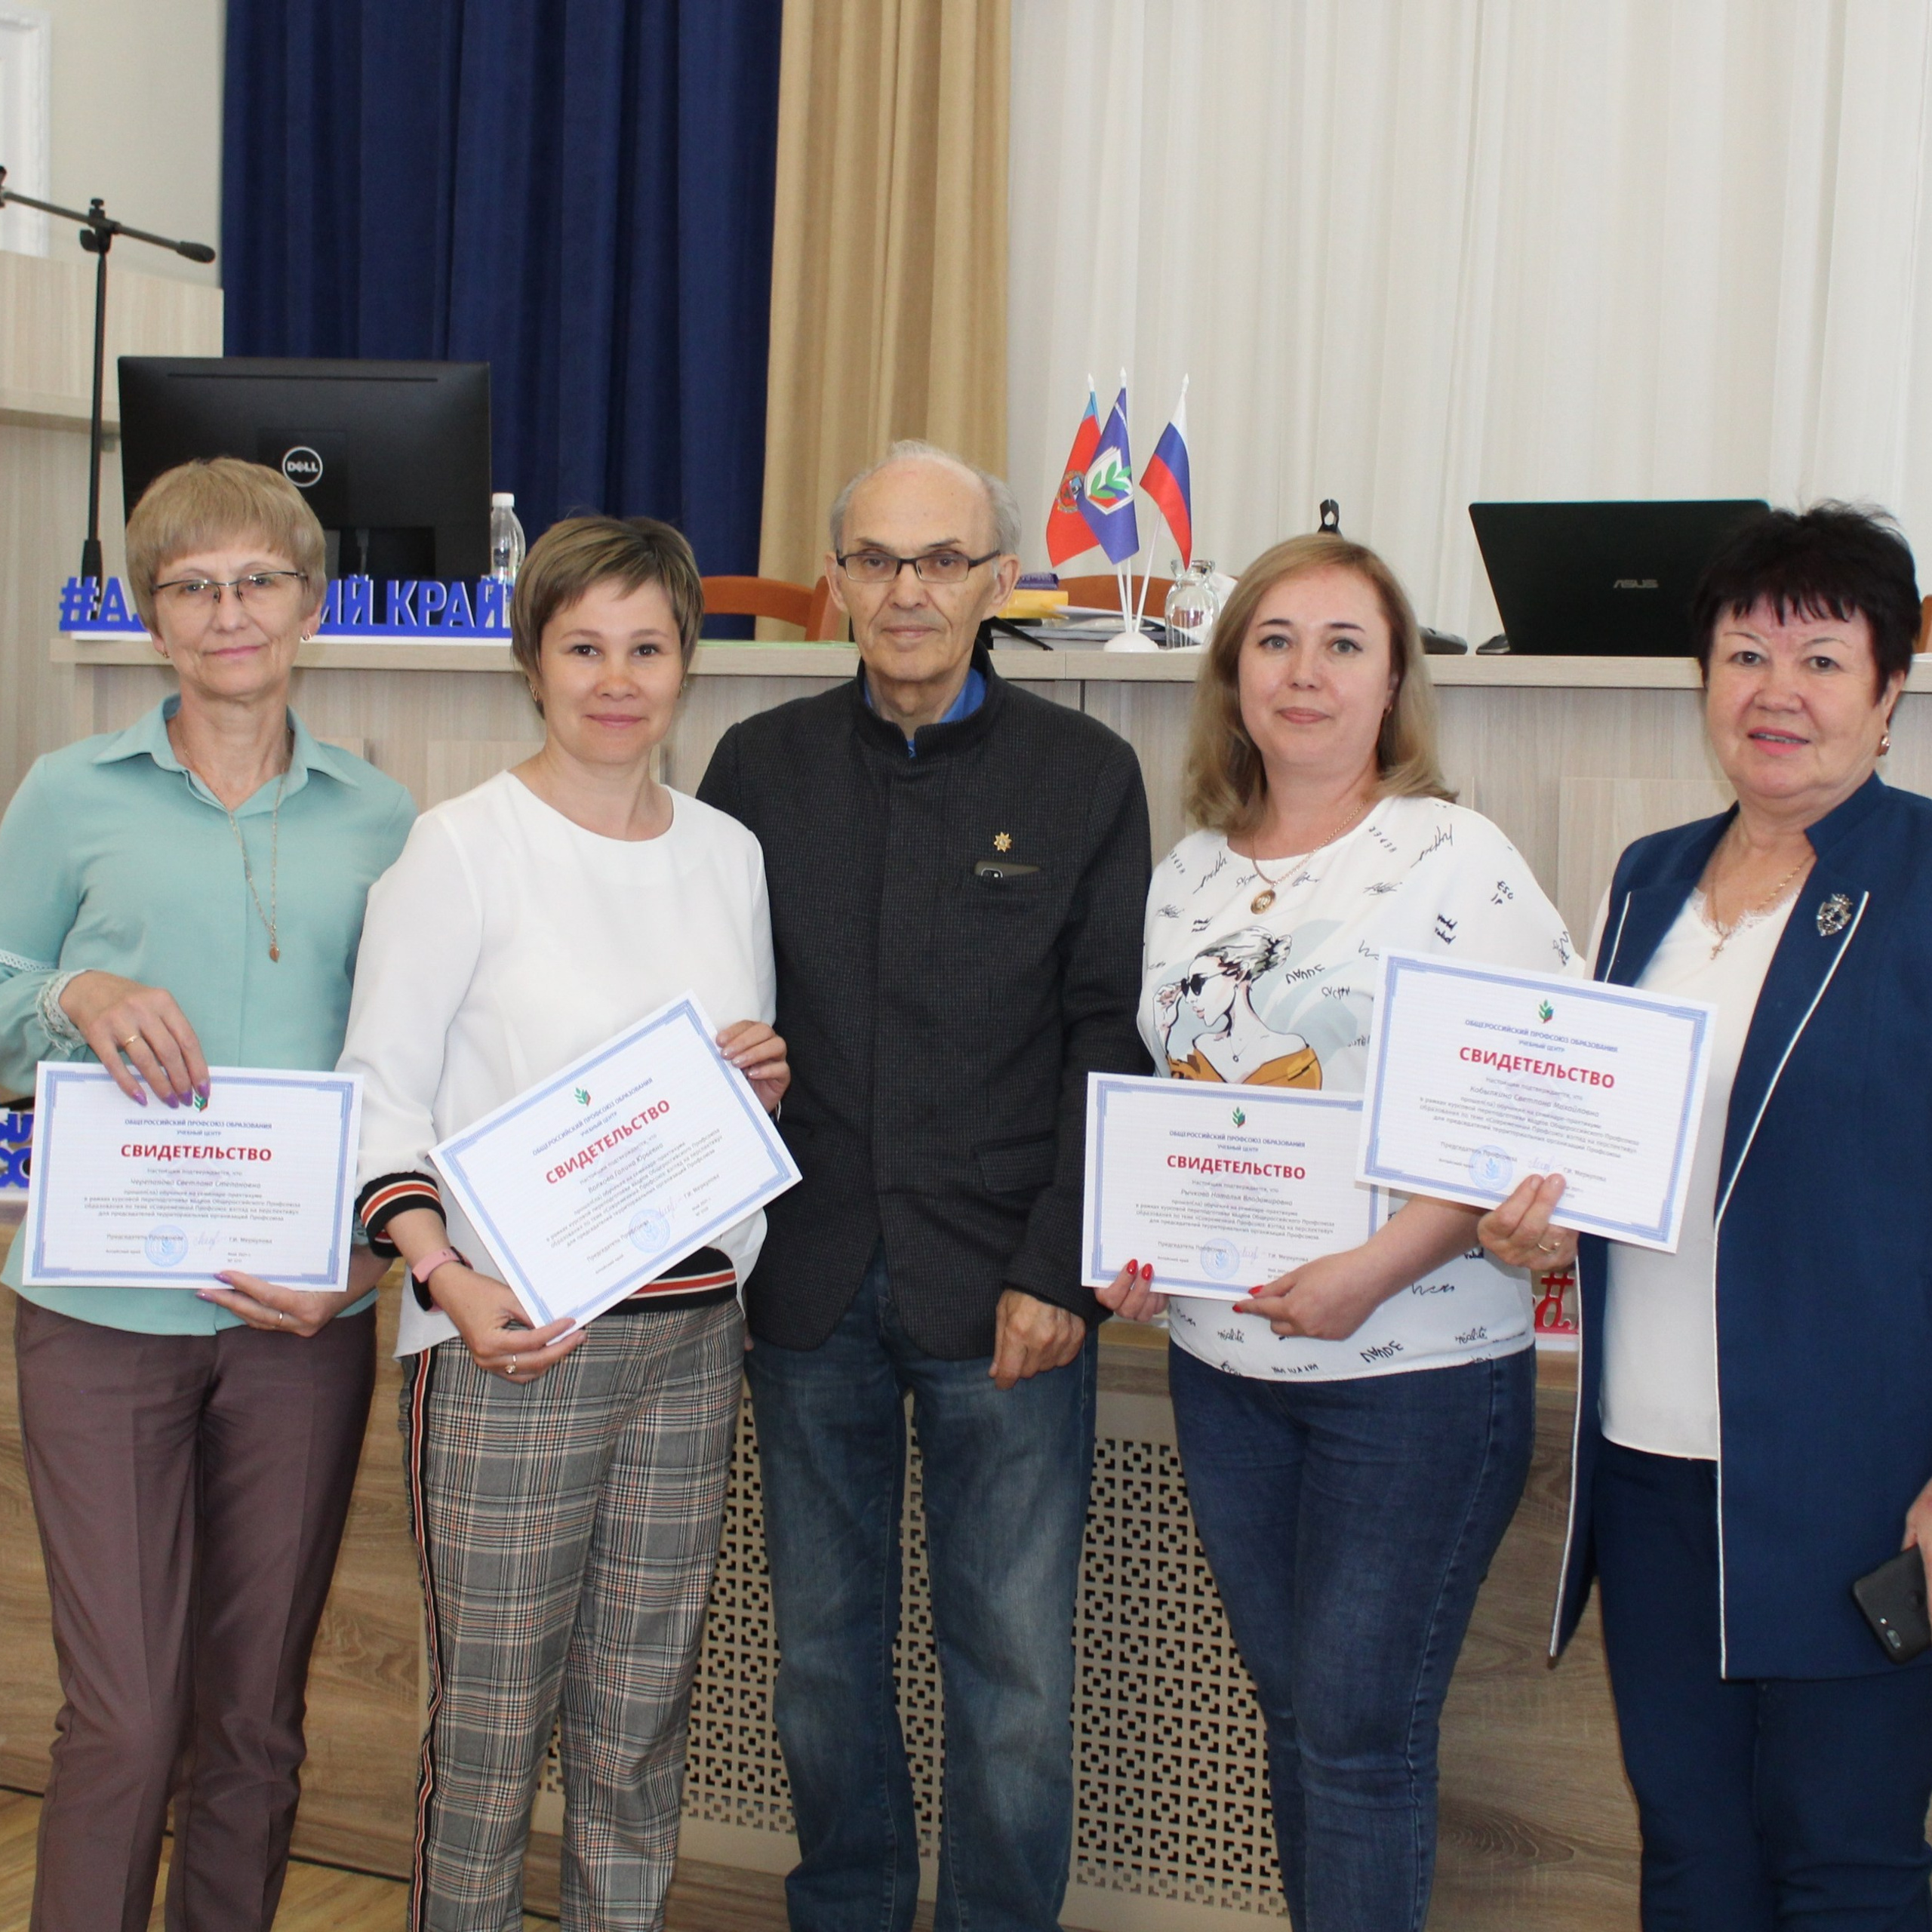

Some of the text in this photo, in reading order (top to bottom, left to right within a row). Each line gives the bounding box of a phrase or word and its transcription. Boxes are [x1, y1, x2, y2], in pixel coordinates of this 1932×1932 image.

[287, 461, 318, 472] DELL
[1614, 579, 1659, 589] ASUS
[386, 575, 509, 632] КРАЙ
[1466, 1018, 1618, 1054] ОБЩЕРОССИЙСКИЙ ПРОФСОЮЗ ОБРАЗОВАНИЯ
[1460, 1045, 1615, 1088] СВИДЕТЕЛЬСТВО
[532, 1077, 654, 1155] ОБЩЕРОССИЙСКИЙ ПРОФСОЮЗ ОБРАЗОВАНИЯ
[121, 1143, 272, 1161] СВИДЕТЕЛЬСТВО
[544, 1099, 670, 1183] СВИДЕТЕЛЬСТВО
[1170, 1130, 1305, 1148] ОБЩЕРОССИЙСКИЙ ПРОФСОЮЗ ОБРАЗОВАНИЯ
[1168, 1154, 1306, 1180] СВИДЕТЕЛЬСТВО
